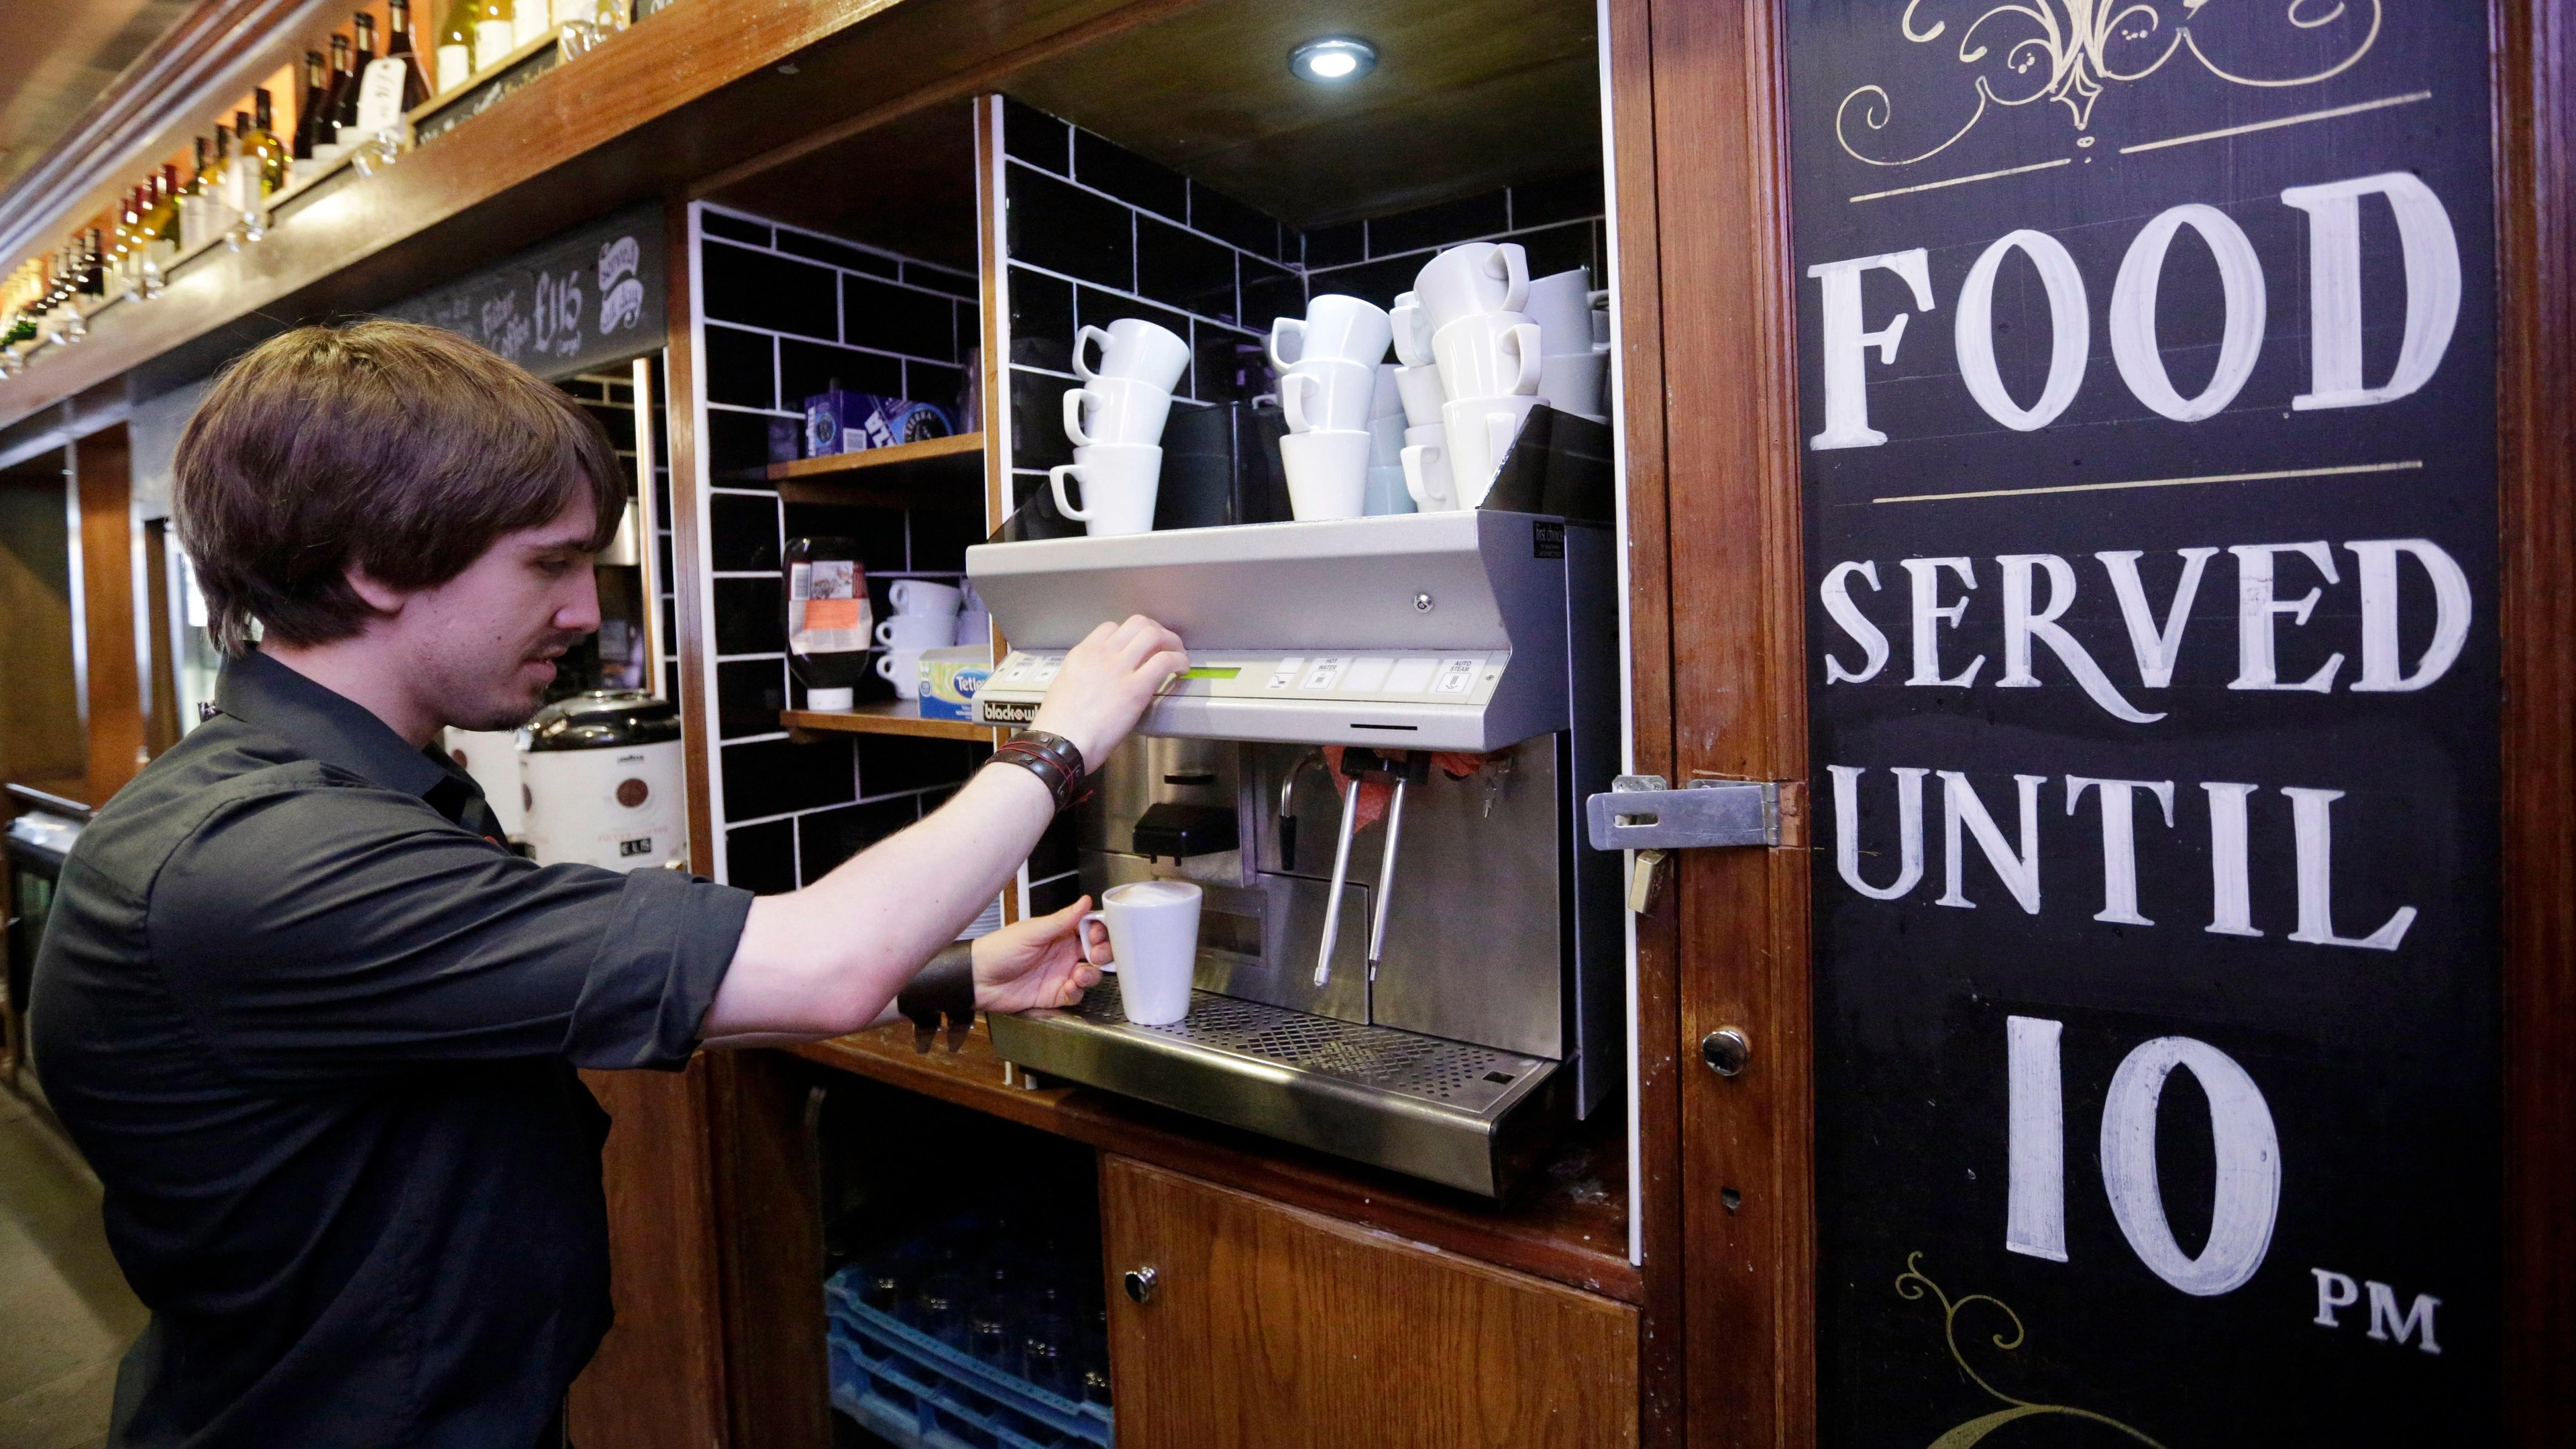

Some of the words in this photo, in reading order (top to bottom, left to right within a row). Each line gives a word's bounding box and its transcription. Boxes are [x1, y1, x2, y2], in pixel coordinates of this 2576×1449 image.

[1807, 170, 2463, 451] FOOD
[955, 676, 985, 692] Tetle
[1819, 538, 2473, 723] SERVED
[1826, 764, 2417, 951] UNTIL
[2006, 1014, 2282, 1297] 10
[2310, 1267, 2443, 1354] PM
